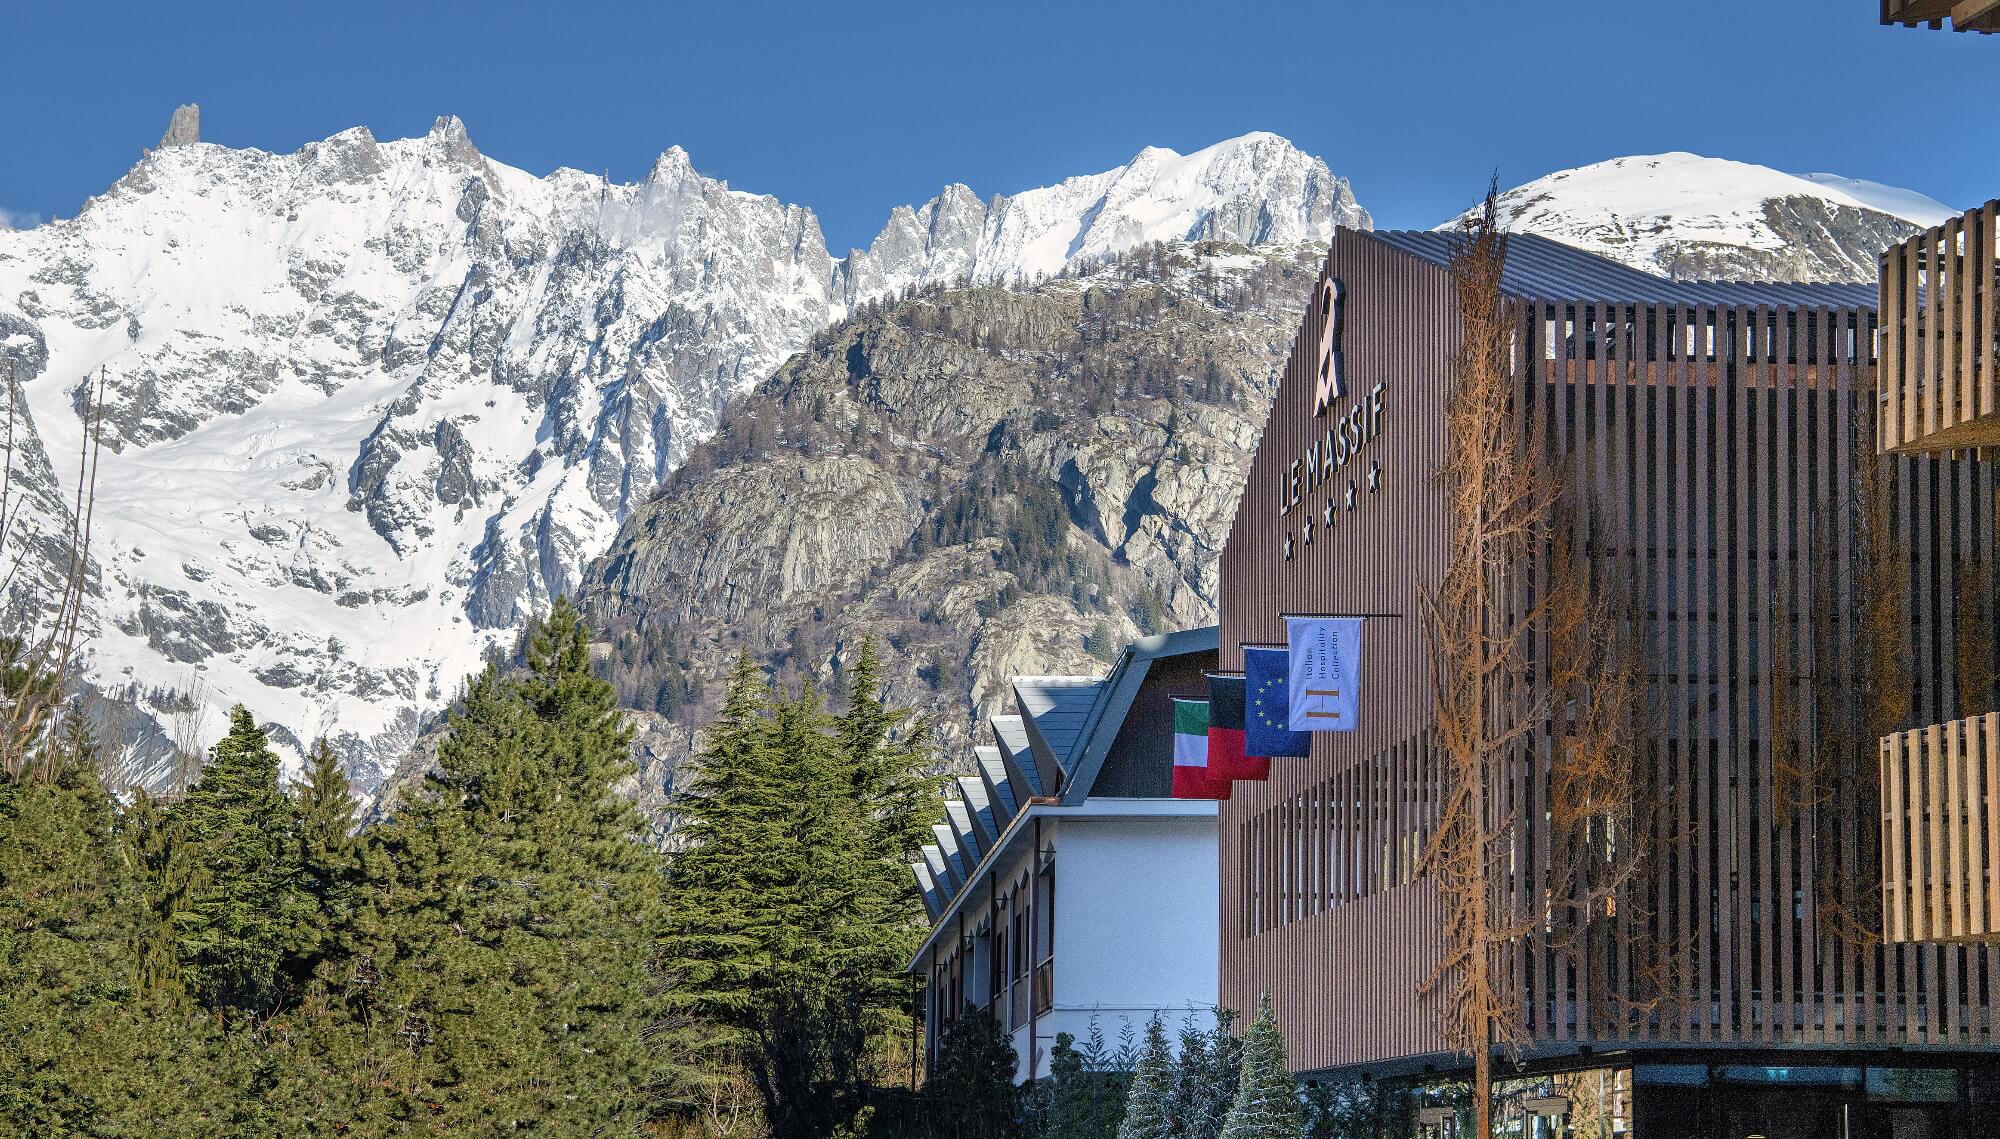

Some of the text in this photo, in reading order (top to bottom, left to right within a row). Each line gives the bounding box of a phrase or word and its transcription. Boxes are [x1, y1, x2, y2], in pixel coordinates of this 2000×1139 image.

[1307, 381, 1387, 494] MASSIF
[1318, 626, 1327, 679] Hospitality
[1331, 631, 1340, 680] Collection
